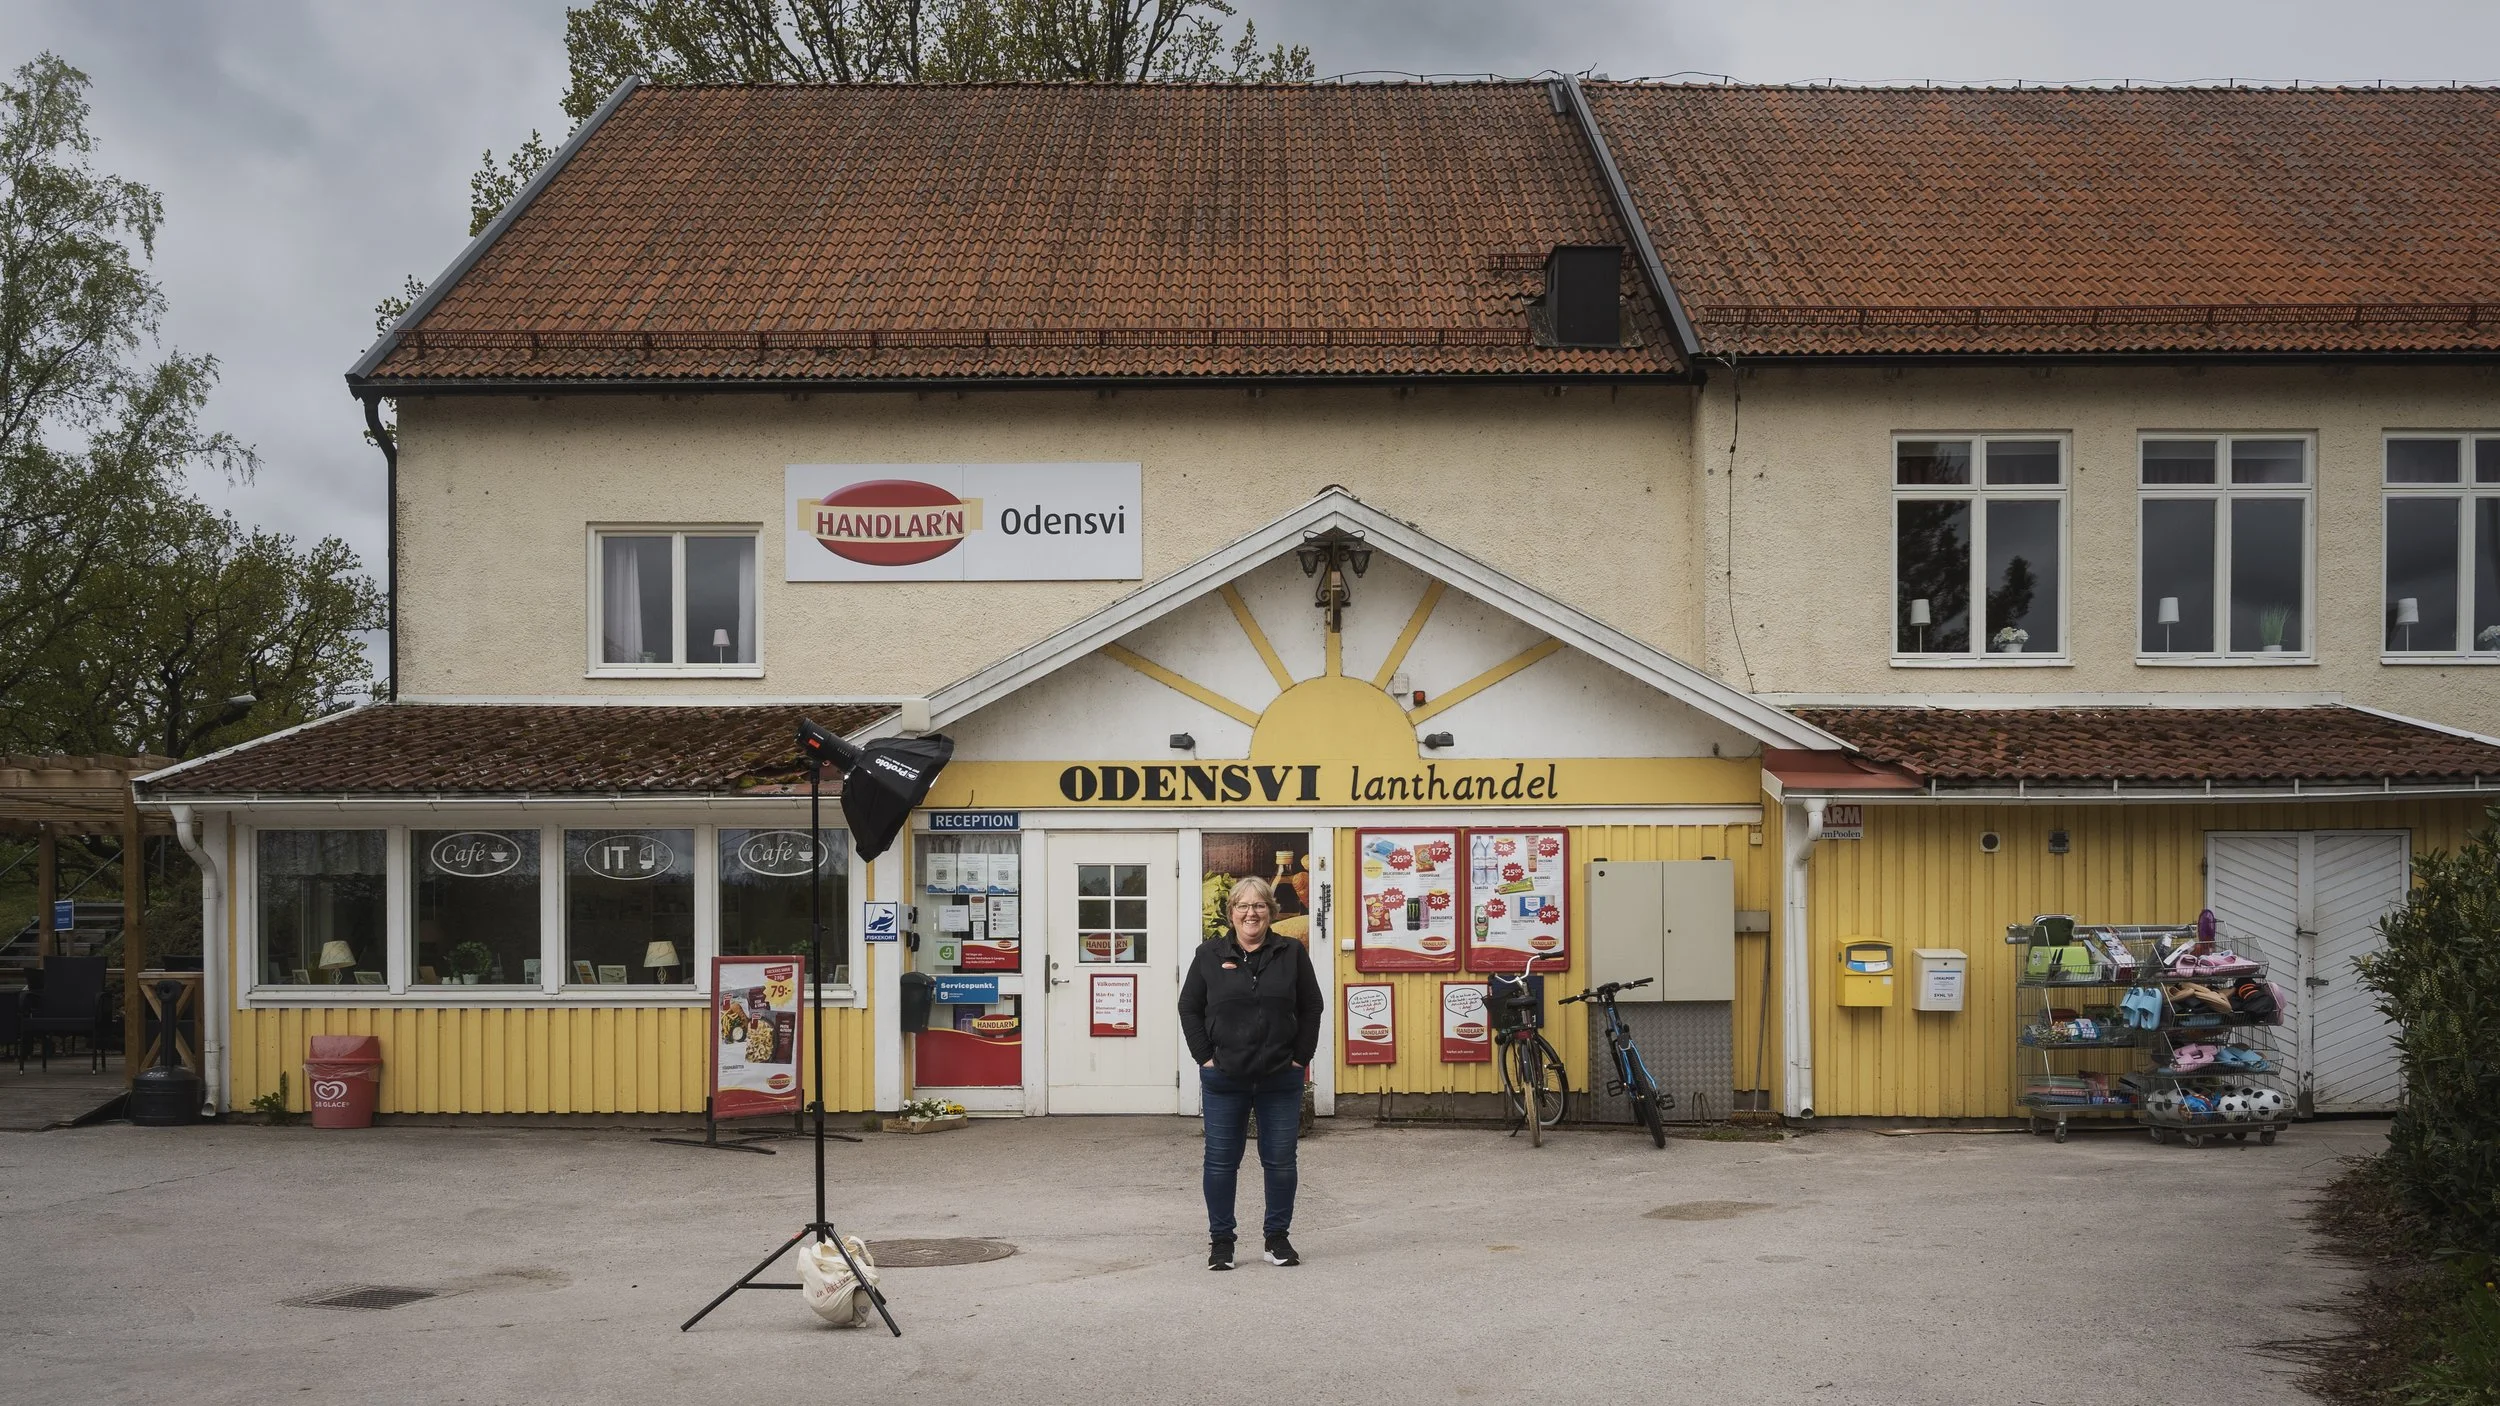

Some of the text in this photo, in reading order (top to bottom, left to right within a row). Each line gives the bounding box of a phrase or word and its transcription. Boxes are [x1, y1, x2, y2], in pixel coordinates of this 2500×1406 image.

[816, 504, 1125, 538] HANDLAR'N Odensvi
[875, 758, 908, 780] Profoto
[1059, 763, 1559, 802] ODENSVI lanthandel
[935, 815, 1013, 827] RECEPTION
[1823, 806, 1860, 824] ARM
[1821, 830, 1861, 838] rmPoolen
[441, 842, 485, 868] Café
[603, 846, 630, 870] IT
[749, 842, 793, 867] Café
[770, 985, 792, 998] 79:-
[940, 982, 995, 990] Servicepunkt.
